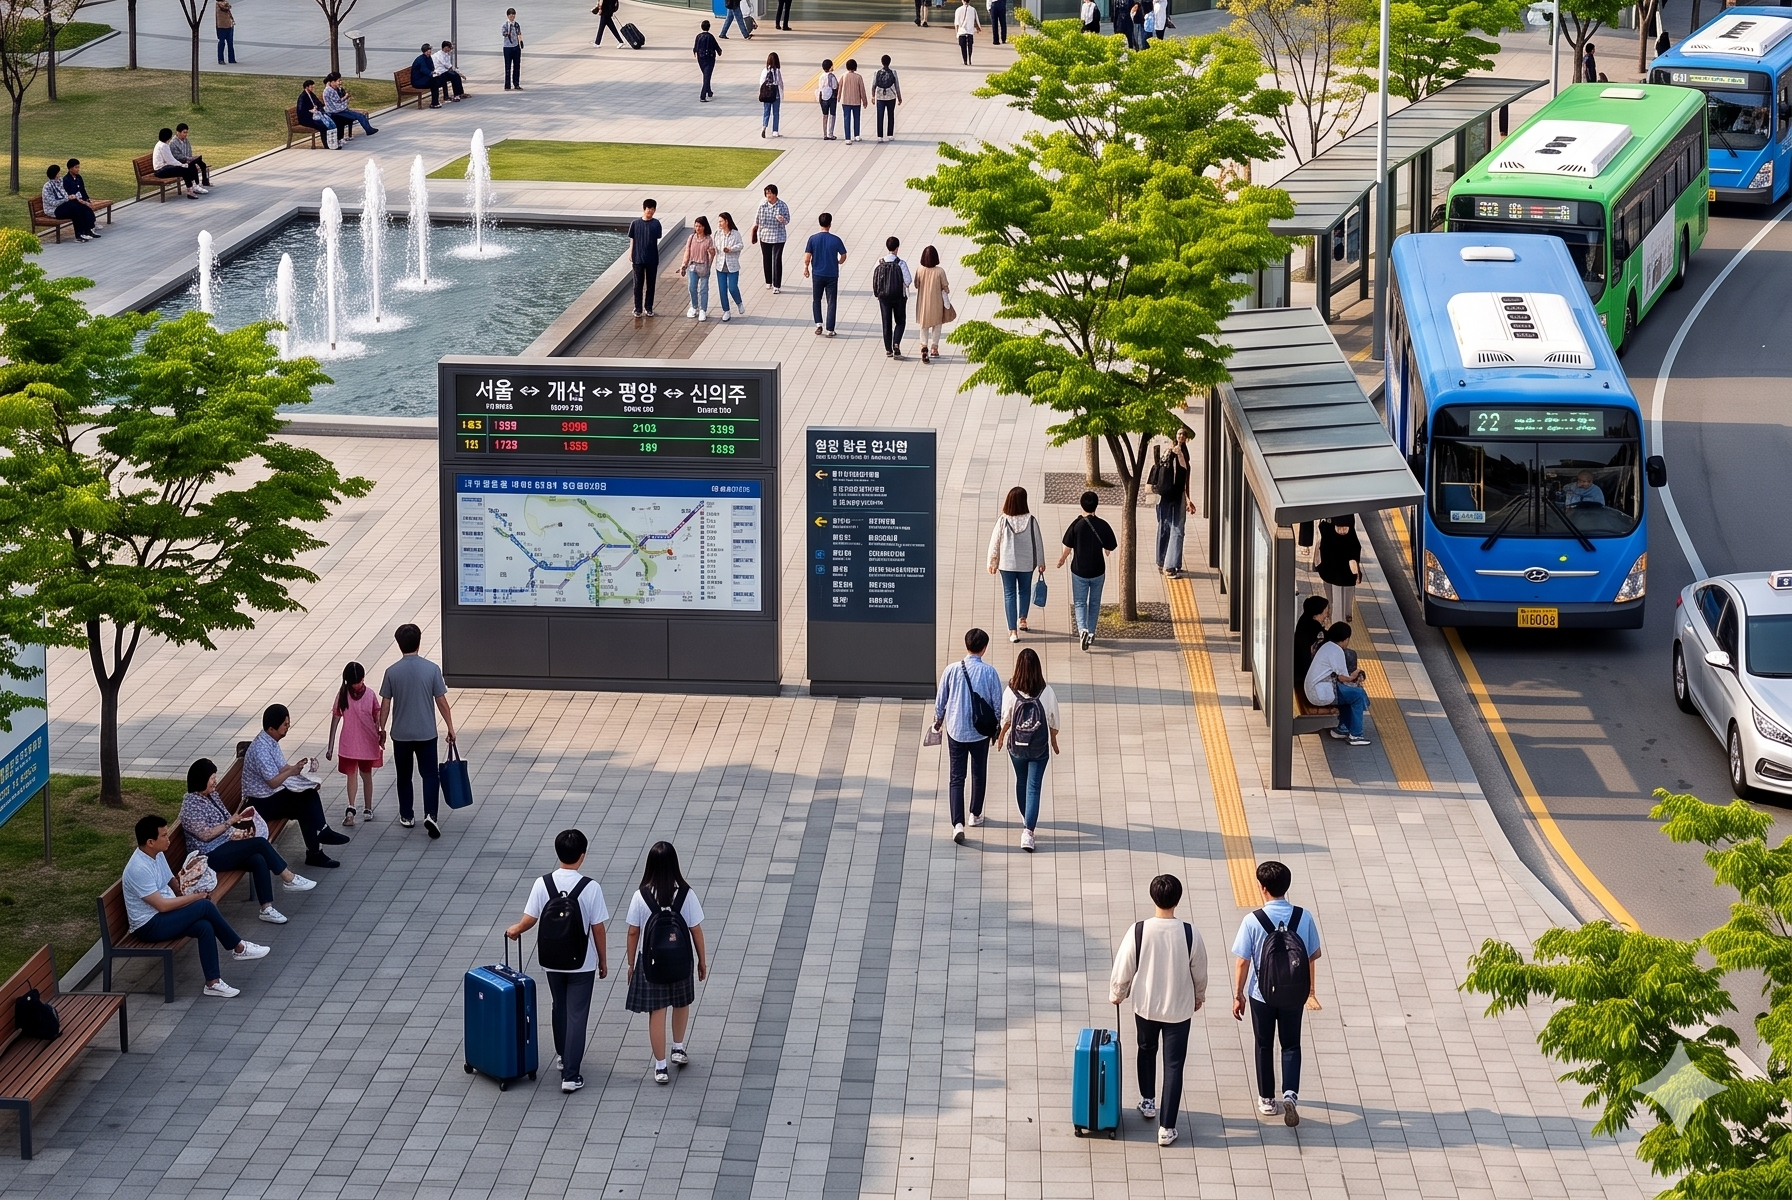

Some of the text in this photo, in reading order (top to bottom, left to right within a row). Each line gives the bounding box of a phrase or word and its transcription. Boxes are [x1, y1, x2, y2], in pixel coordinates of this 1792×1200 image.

[475, 379, 514, 401] 서울
[618, 382, 658, 404] 평양
[690, 383, 747, 405] 신의주
[632, 423, 657, 433] 2103
[1477, 413, 1501, 432] 22
[639, 443, 658, 452] 189
